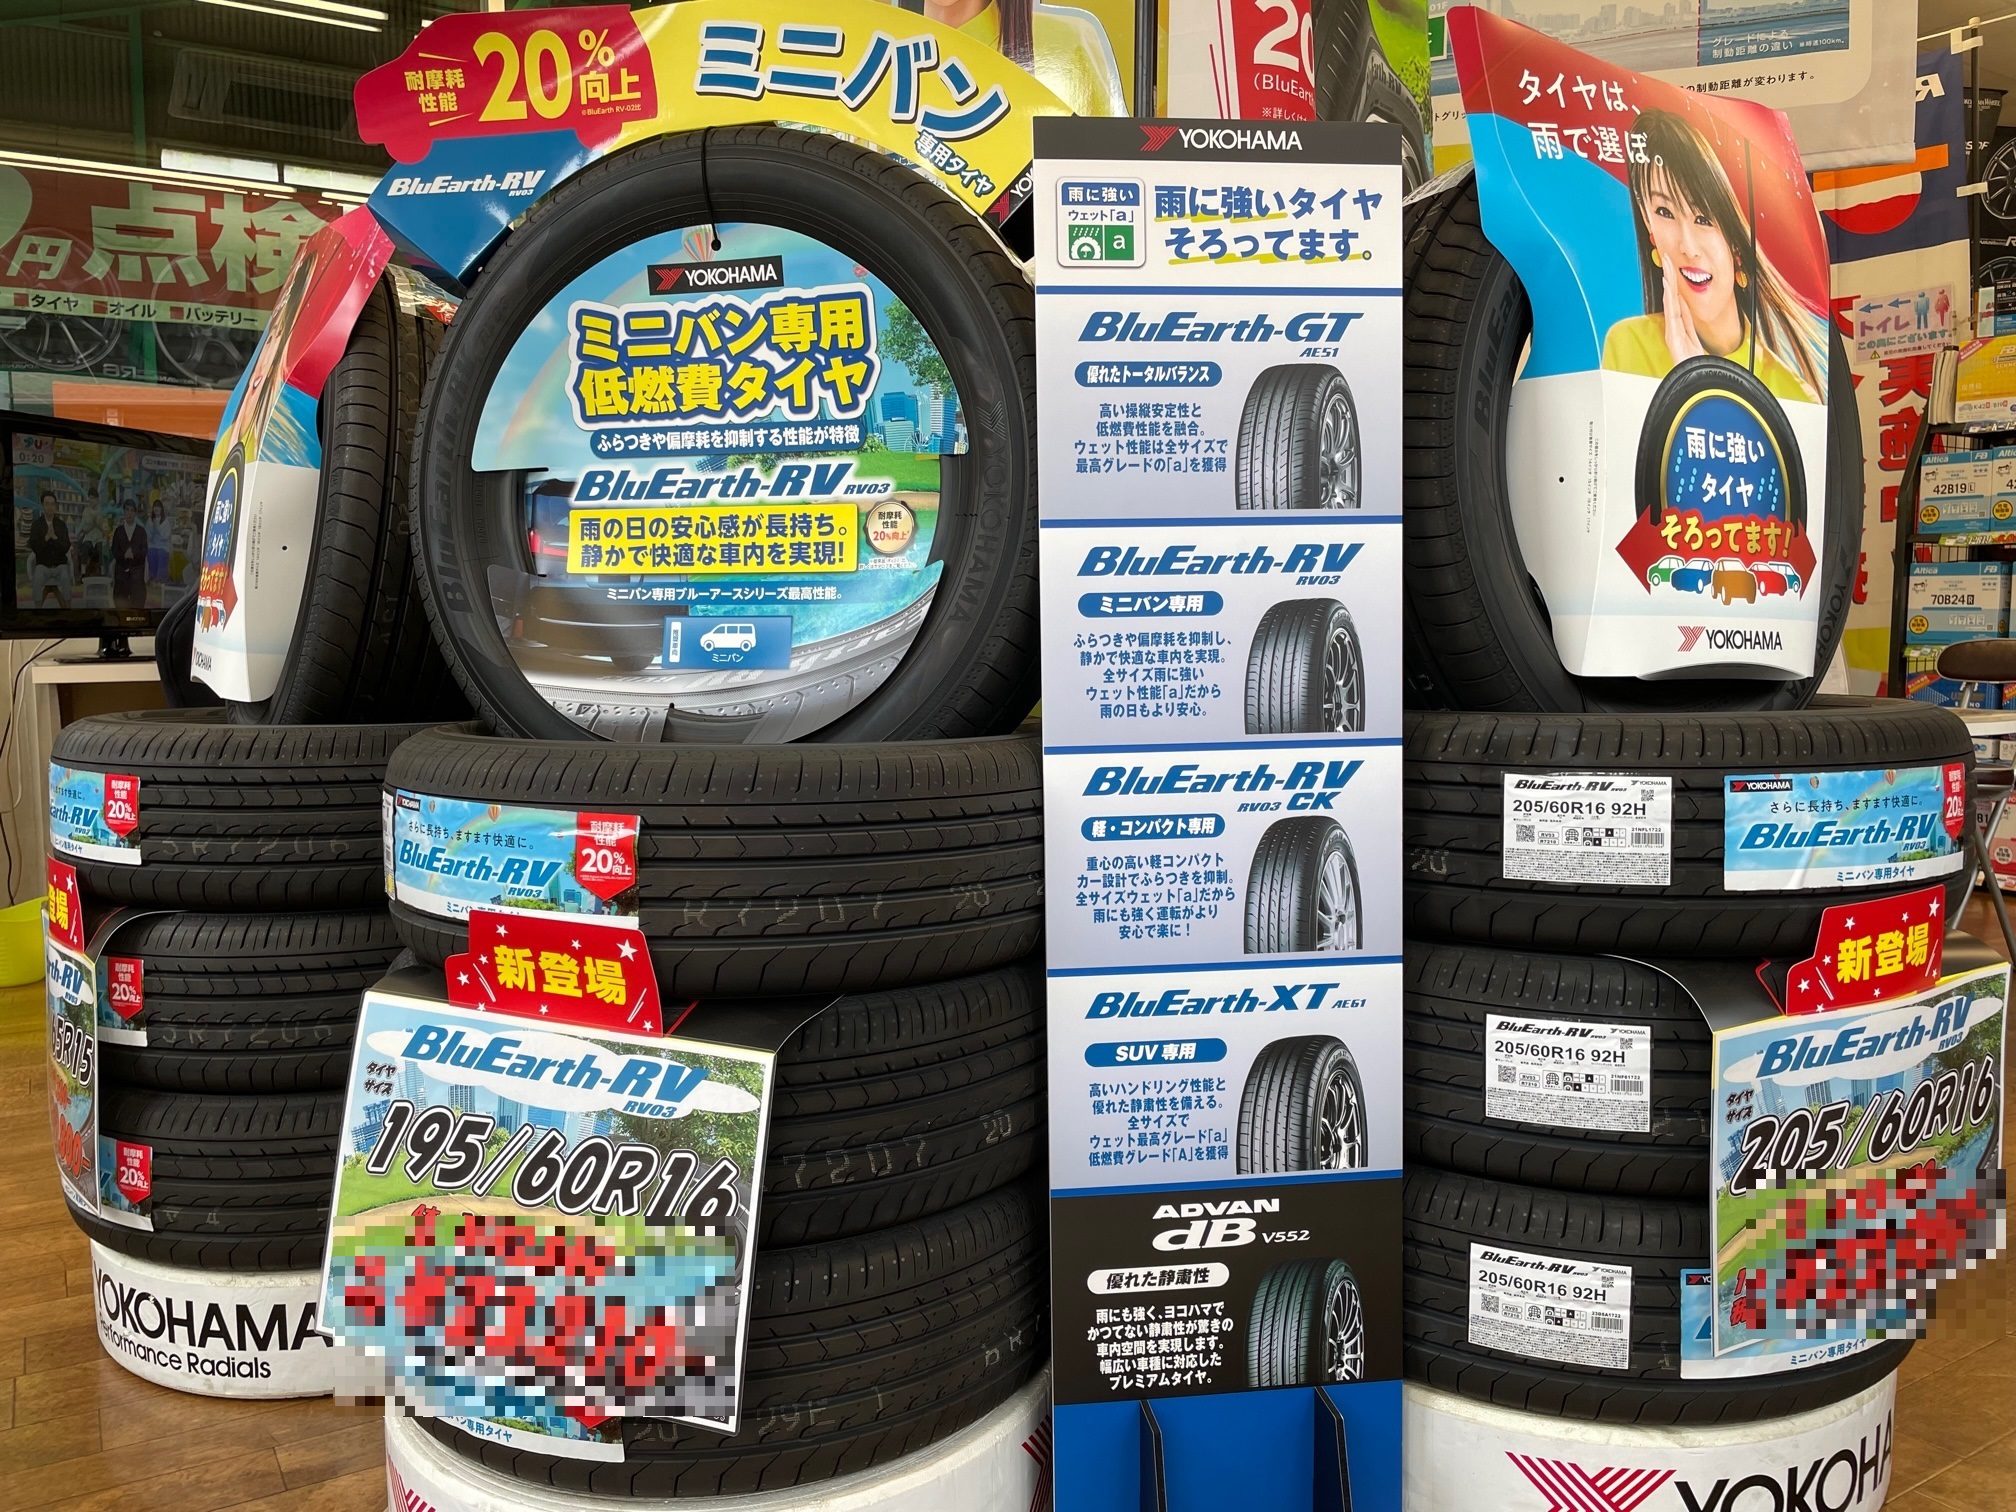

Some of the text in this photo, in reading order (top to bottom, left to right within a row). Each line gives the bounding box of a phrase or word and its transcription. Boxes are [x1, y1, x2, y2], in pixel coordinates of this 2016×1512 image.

[1712, 29, 1790, 47] グレードによる
[1712, 41, 1794, 59] 制動距離の違い
[404, 68, 466, 91] 耐摩耗
[579, 68, 642, 105] 向上
[694, 20, 1009, 138] ミニバン
[418, 92, 459, 113] 性能
[1518, 69, 1641, 116] タイヤは、
[1178, 129, 1303, 150] YOKOHAMA
[1527, 122, 1665, 167] 雨で選ぼ。
[915, 132, 994, 195] 専用タイヤ
[387, 169, 546, 197] BluEarth-RV
[508, 189, 534, 197] RV03
[1068, 187, 1134, 202] 雨に強い
[1155, 185, 1383, 220] 雨に強いタイヤ
[1068, 209, 1134, 222] ウェット「a」
[1113, 232, 1126, 250] a
[1165, 227, 1372, 261] そろってます。
[684, 263, 778, 287] YOKOHAMA
[31, 293, 80, 311] タイヤ
[109, 302, 157, 320] オイル
[186, 306, 258, 327] バッテリー
[1078, 311, 1365, 342] BluEarth-GT
[1860, 315, 1910, 337] トイレ
[579, 297, 866, 362] ミニバン専用
[1300, 347, 1339, 357] AE51
[1087, 365, 1210, 383] 優れたトータルバランス
[578, 356, 869, 417] 低燃費タイヤ
[1099, 403, 1202, 419] 高い操縦安定性と
[596, 425, 861, 452] ふらつきや偏摩耗を抑制する性能が特徴
[1096, 421, 1206, 437] 低燃費性能を融合。
[1074, 439, 1228, 455] ウェット性能は全サイズで
[1686, 427, 1764, 464] 雨に強い
[1076, 457, 1228, 473] 最高グレードの「a」を獲得
[1924, 456, 1949, 464] Altica
[573, 463, 854, 502] BluEarth-RV
[844, 482, 891, 495] RV03
[1701, 475, 1754, 507] タイヤ
[1933, 483, 1967, 495] 42B19
[877, 511, 903, 521] 耐摩耗
[882, 520, 898, 530] 性能
[579, 512, 848, 541] 雨の日の安心感が長持ち。
[1660, 514, 1794, 557] そろってます!
[580, 542, 846, 569] 静かで快適な車内を実現!
[1077, 543, 1365, 576] BluEarth-RV
[1296, 575, 1341, 585] RV03
[1913, 566, 1939, 575] Altica
[607, 586, 844, 601] ミニバン専用ブルーアースシリーズ最高性能。
[1930, 594, 1966, 605] 70B24
[1100, 595, 1204, 613] ミニバン専用
[1074, 632, 1232, 648] ふらつきや偏摩耗を抑制し、
[1705, 628, 1783, 651] YOKOHAMA
[711, 653, 744, 663] ミニバン
[1080, 650, 1226, 666] 静かで快適な車内を実現。
[1103, 667, 1205, 683] 全サイズ雨に強い
[1085, 684, 1222, 701] ウェット性能「a」だから
[1100, 702, 1208, 718] 雨の日もより安心。
[1082, 760, 1365, 796] BluEarth-RV
[1514, 779, 1614, 792] BluEarth-RV
[1746, 781, 1791, 791] YOKOHAMA
[1237, 792, 1341, 812] RV03 CK
[1513, 799, 1647, 816] 205/60R16 92H
[1769, 795, 1923, 814] さらに長持ち、ますます快適に。
[408, 820, 535, 851] さらに長持ち、ますます快適に。
[1092, 818, 1215, 838] 軽・コンパクト専用
[1739, 812, 1938, 849] BluEarth-RV
[1903, 841, 1926, 851] RV03
[399, 839, 563, 888] BluEarth-RV
[613, 864, 633, 876] 向上
[1086, 853, 1225, 870] 重心の高い軽コンパクト
[1077, 870, 1234, 888] カー設計でふらつきを抑制。
[1836, 866, 1916, 882] ミニバン専用タイヤ
[507, 887, 542, 898] RV03
[1075, 887, 1236, 907] 全サイズウェット「a」だから
[1093, 905, 1219, 923] 雨にも強く運転がより
[1119, 923, 1191, 939] 安心で楽に!
[1837, 922, 1930, 984] 新登場
[494, 945, 627, 1006] 新登場
[1085, 983, 1341, 1020] BluEarth-XT
[1331, 998, 1367, 1009] AE61
[1496, 1021, 1594, 1038] BluEarth-RV
[1756, 992, 1975, 1079] BluEarth-RV
[52, 1014, 94, 1087] 5R15
[1115, 1042, 1197, 1062] SUV 専用
[1495, 1040, 1626, 1063] 205/60R16 92H
[1938, 1033, 1963, 1053] RV03
[366, 1061, 397, 1078] タイヤ
[401, 1024, 712, 1103] BluEarth-RV
[364, 1079, 393, 1096] サイズ
[1089, 1077, 1226, 1098] 高いハンドリング性能と
[1726, 1088, 1755, 1106] タイヤ
[622, 1100, 676, 1120] RV03
[1092, 1095, 1223, 1115] 優れた静粛性を備える。
[1725, 1105, 1753, 1123] サイズ
[1128, 1113, 1190, 1130] 全サイズで
[1729, 1053, 1995, 1197] 205/60R16
[1089, 1128, 1228, 1150] ウェット最高グレード「a」
[366, 1101, 740, 1217] 195/60R16
[1088, 1145, 1229, 1167] 低燃費グレード「A」を獲得
[1152, 1198, 1280, 1220] ADVAN
[1152, 1217, 1311, 1251] dB V552
[1480, 1250, 1576, 1275] BluEarth-RV
[1106, 1266, 1211, 1290] 優れた静粛性
[1478, 1269, 1607, 1301] 205/60R16 92H
[1096, 1301, 1225, 1323] 雨にも強く、ヨコハマで
[1087, 1317, 1234, 1343] かつてない静粛性が驚きの
[1096, 1338, 1224, 1359] 車内空間を実現します。
[187, 1353, 271, 1379] Radials
[1099, 1354, 1222, 1376] 幅広い車種に対応した
[1109, 1370, 1212, 1392] プレミアムタイヤ。
